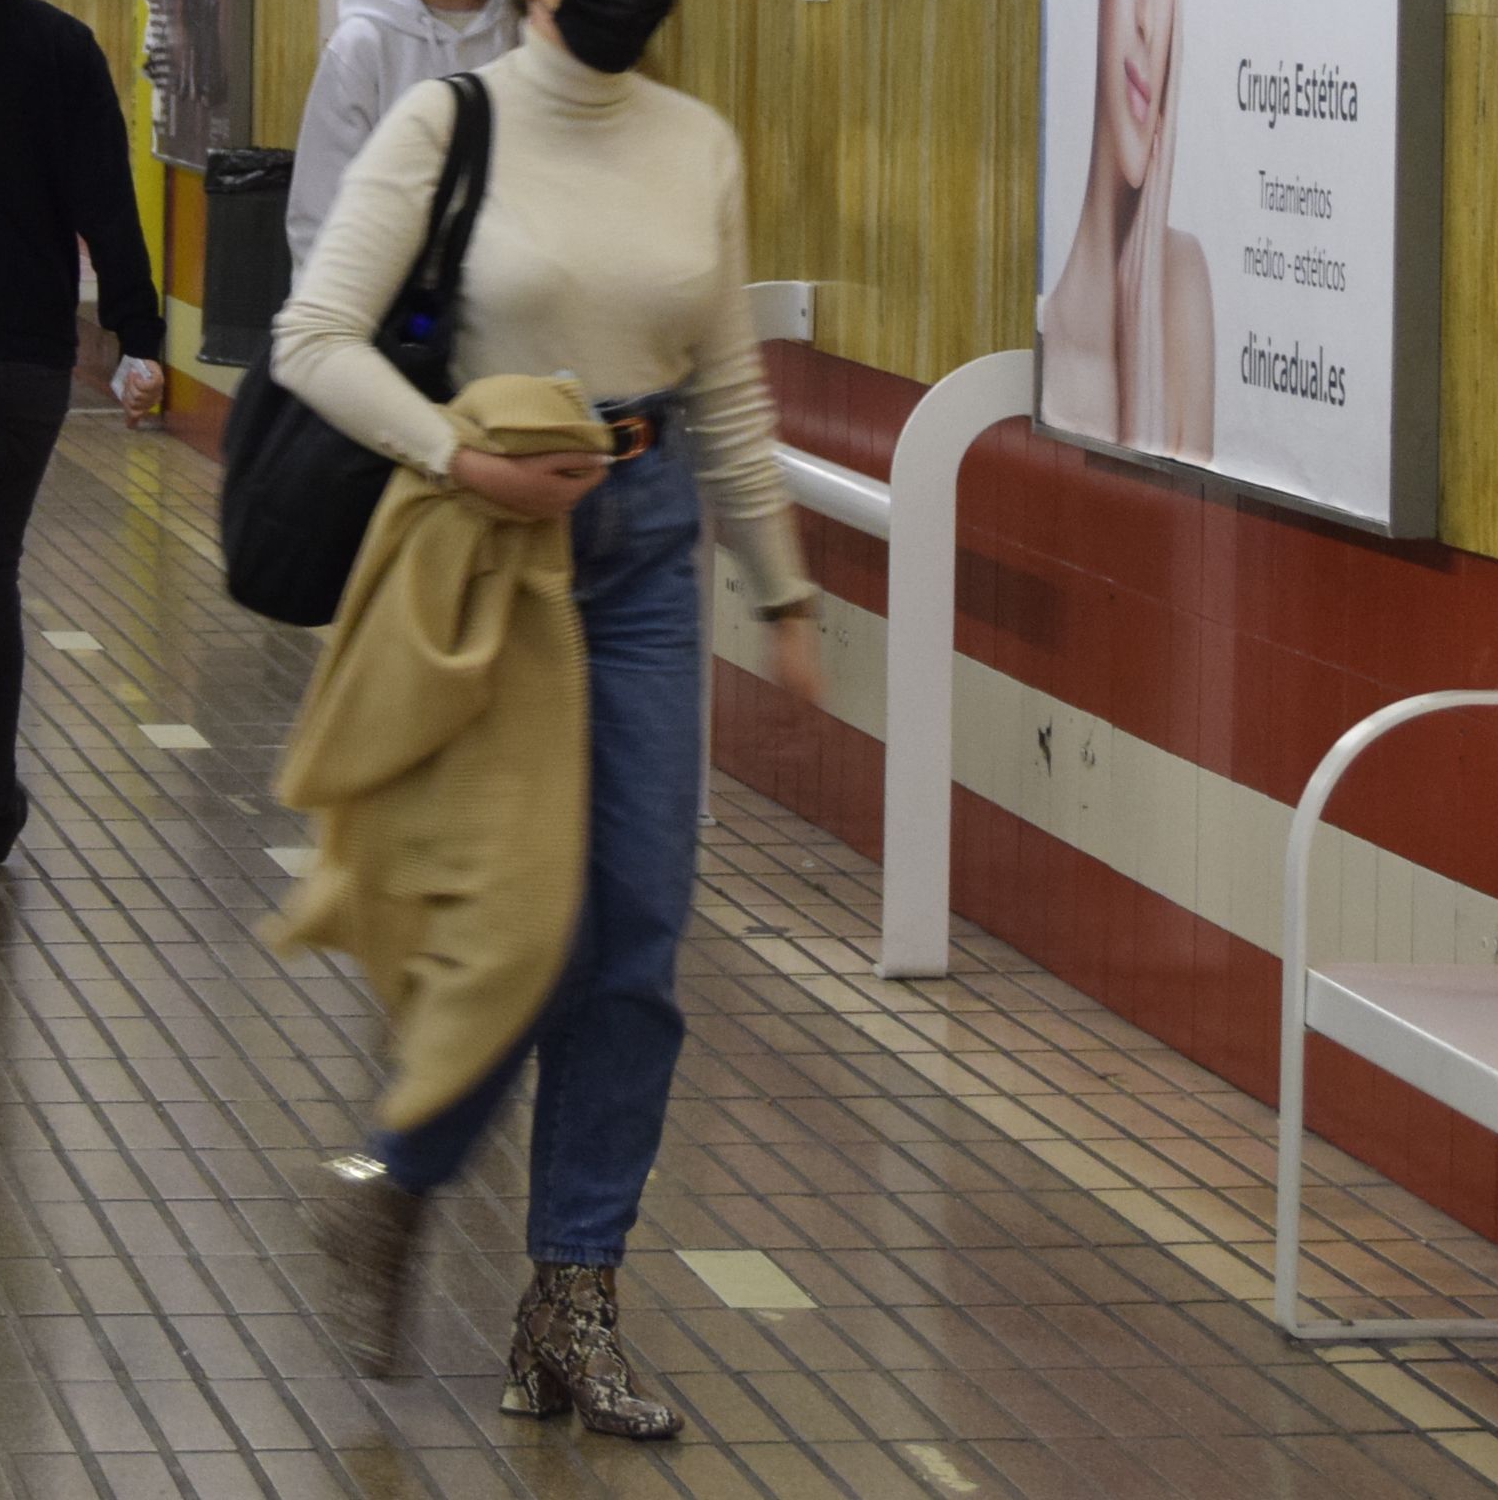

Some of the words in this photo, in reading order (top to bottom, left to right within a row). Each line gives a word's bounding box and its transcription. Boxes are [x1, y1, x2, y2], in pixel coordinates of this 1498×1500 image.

[1237, 58, 1290, 129] Cirugía
[1295, 63, 1358, 123] Estética
[1259, 170, 1332, 220] Tratamientos
[1244, 237, 1285, 281] médico
[1294, 246, 1346, 292] estéticos
[1241, 331, 1347, 407] clinicadual.es
